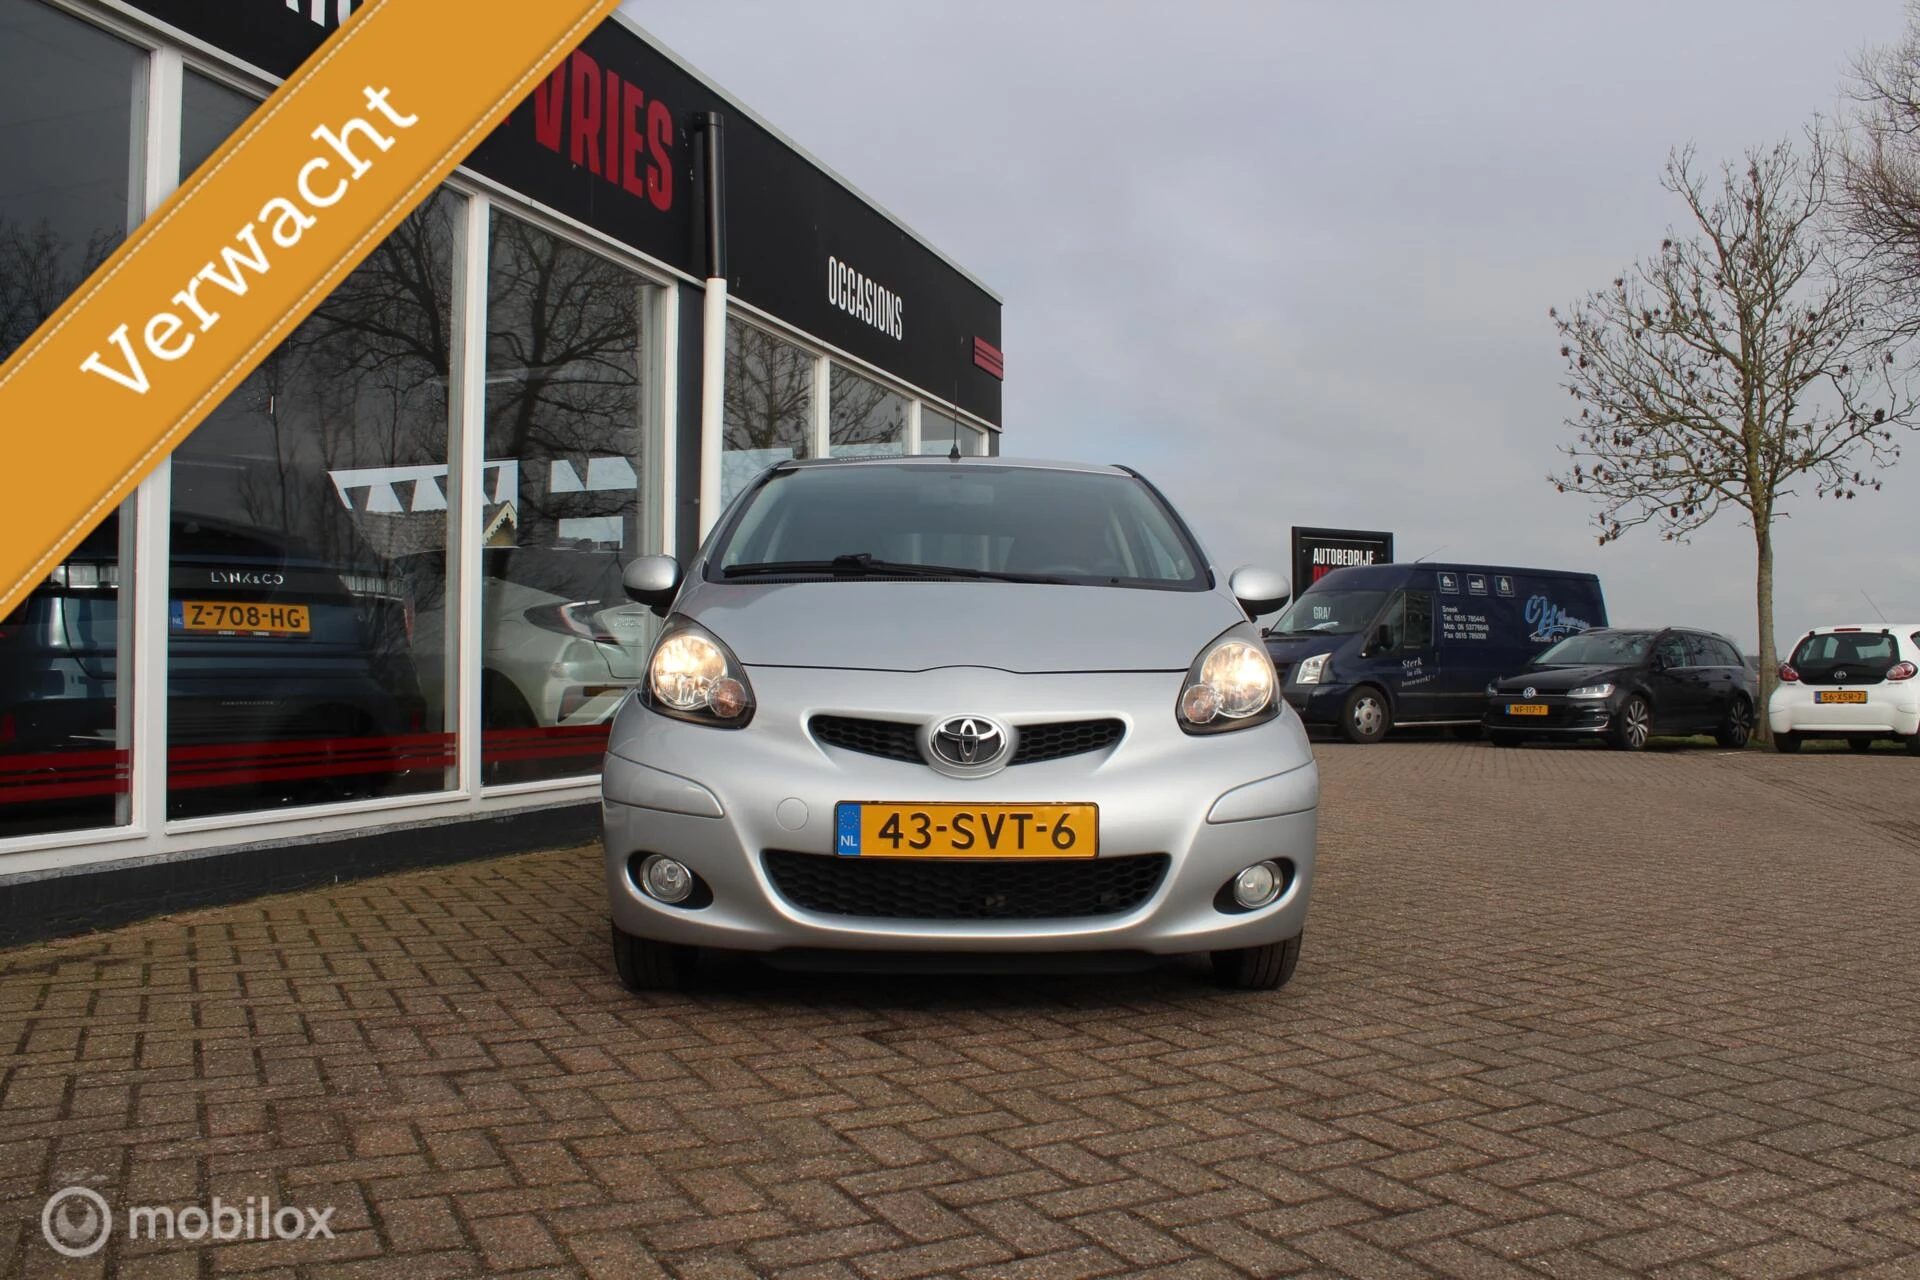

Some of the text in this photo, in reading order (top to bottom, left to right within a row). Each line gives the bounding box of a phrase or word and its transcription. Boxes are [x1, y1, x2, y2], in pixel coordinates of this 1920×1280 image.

[534, 47, 673, 212] VRIES
[828, 255, 903, 342] OCCASIONS
[172, 617, 183, 625] NL
[191, 605, 301, 628] Z-708-HG
[1402, 656, 1423, 669] Sterk
[840, 835, 857, 847] NL
[878, 812, 1076, 850] 43-SVT-6
